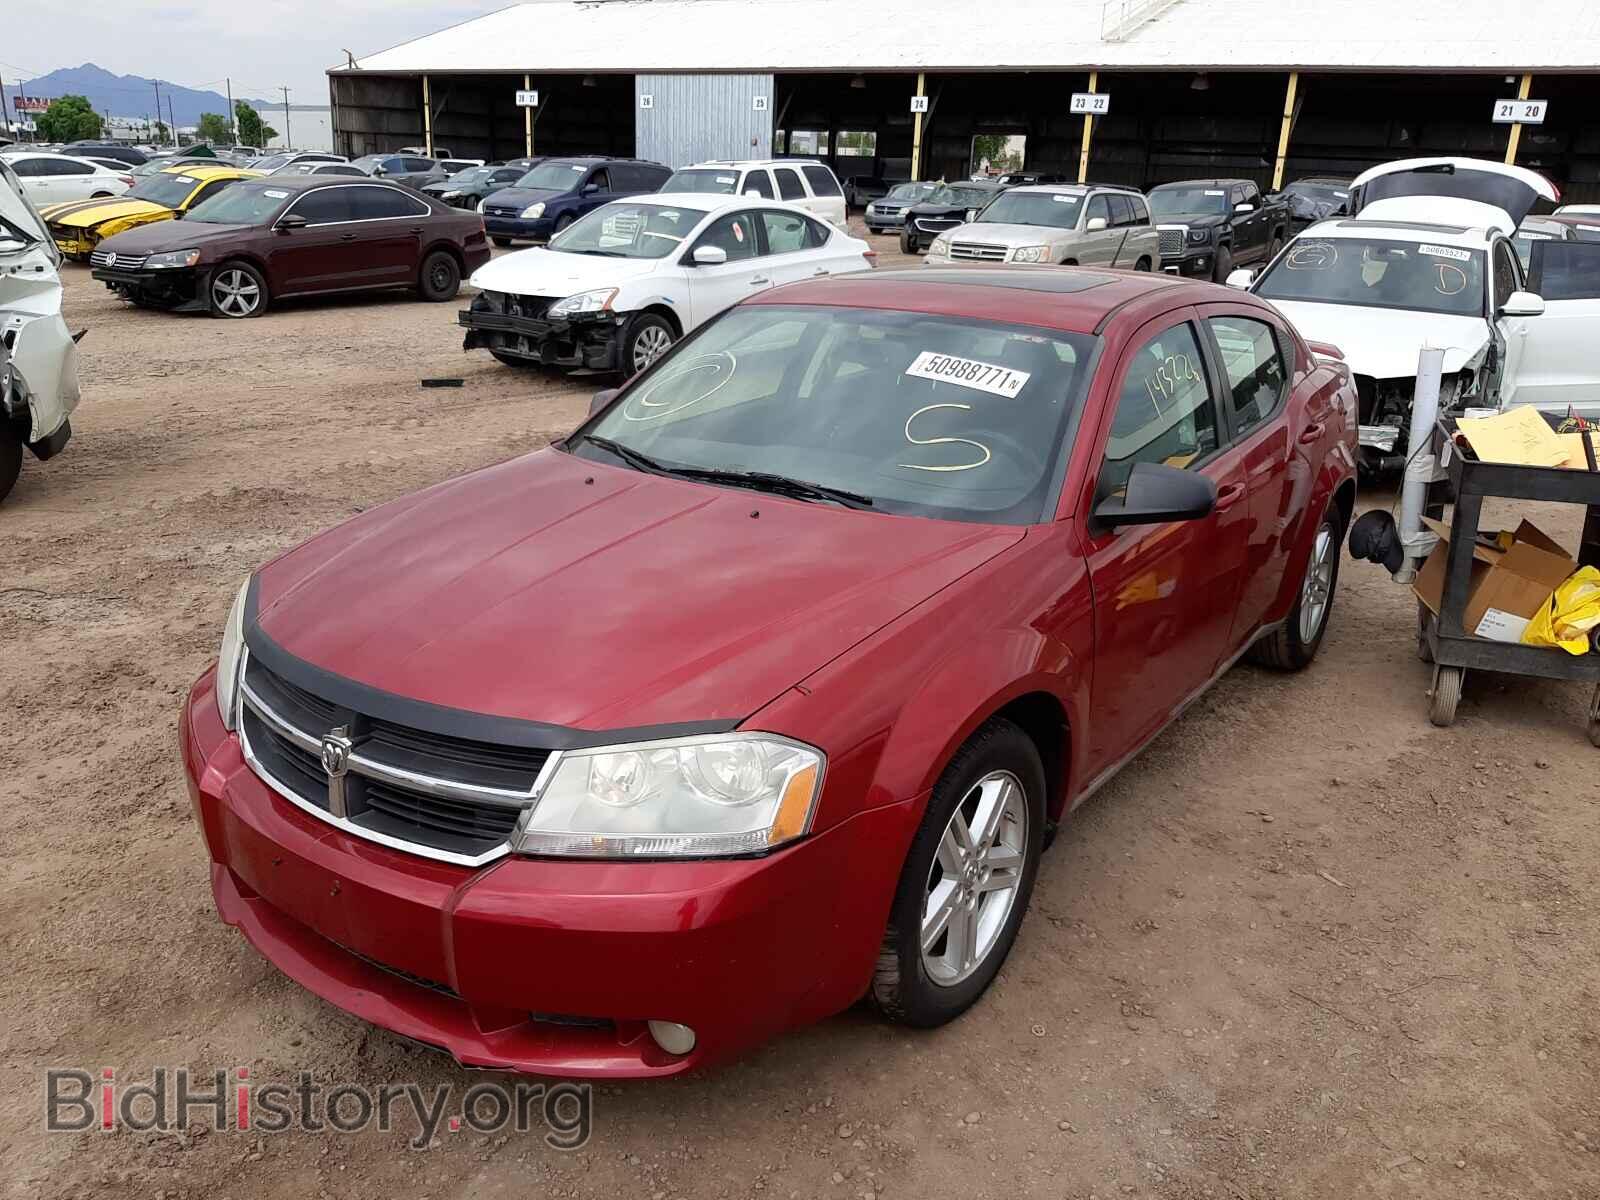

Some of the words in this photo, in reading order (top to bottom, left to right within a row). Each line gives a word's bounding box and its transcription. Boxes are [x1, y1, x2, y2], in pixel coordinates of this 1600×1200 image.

[1075, 98, 1086, 108] 23
[1094, 98, 1105, 109] 22
[1500, 104, 1514, 117] 21
[1525, 105, 1540, 117] 20
[924, 355, 1012, 389] 50988771
[897, 403, 991, 471] S
